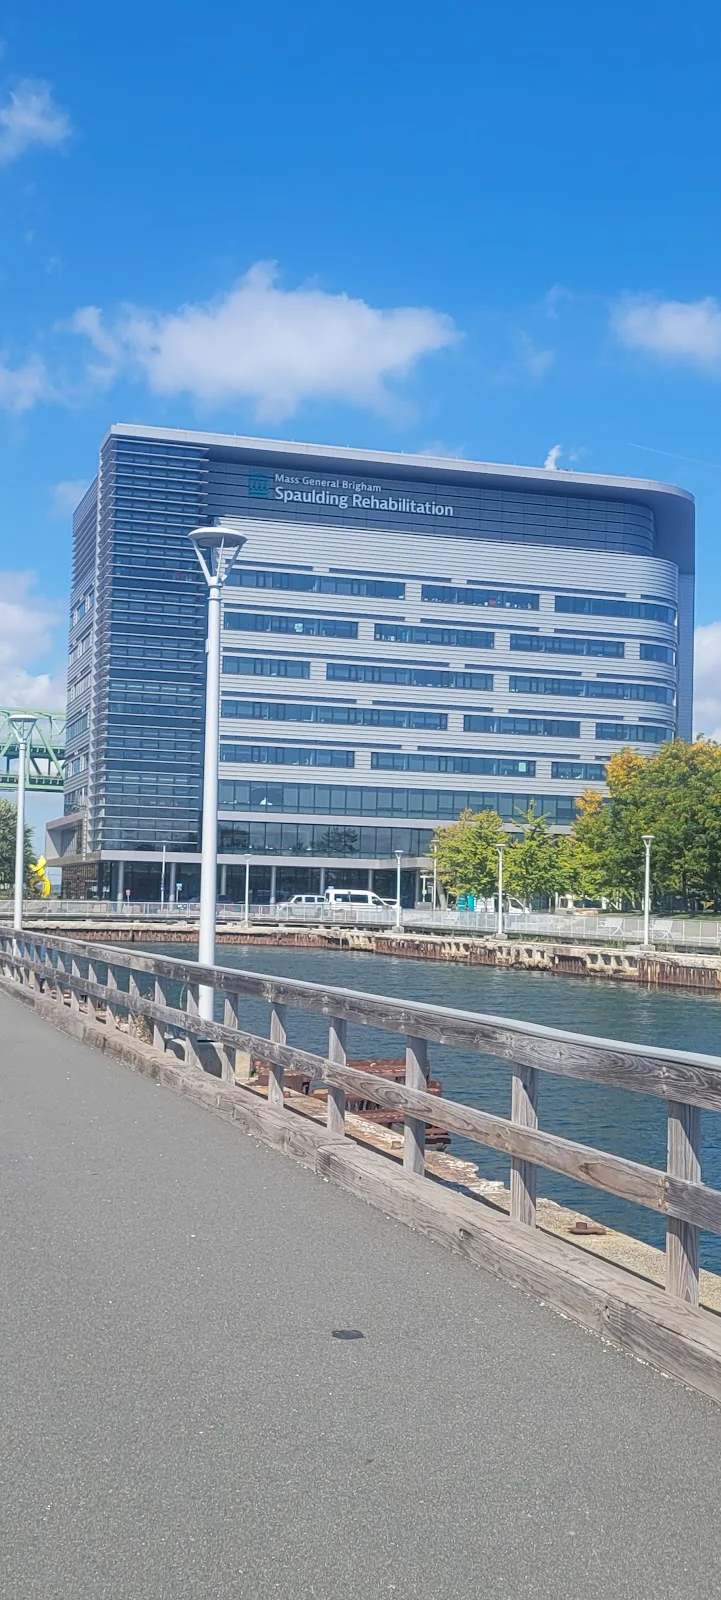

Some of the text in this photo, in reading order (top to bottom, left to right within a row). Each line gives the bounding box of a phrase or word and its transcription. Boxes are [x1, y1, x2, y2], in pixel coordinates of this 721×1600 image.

[275, 473, 382, 493] Mass General Brigham
[275, 486, 454, 516] Spaulding Rehabilitation
